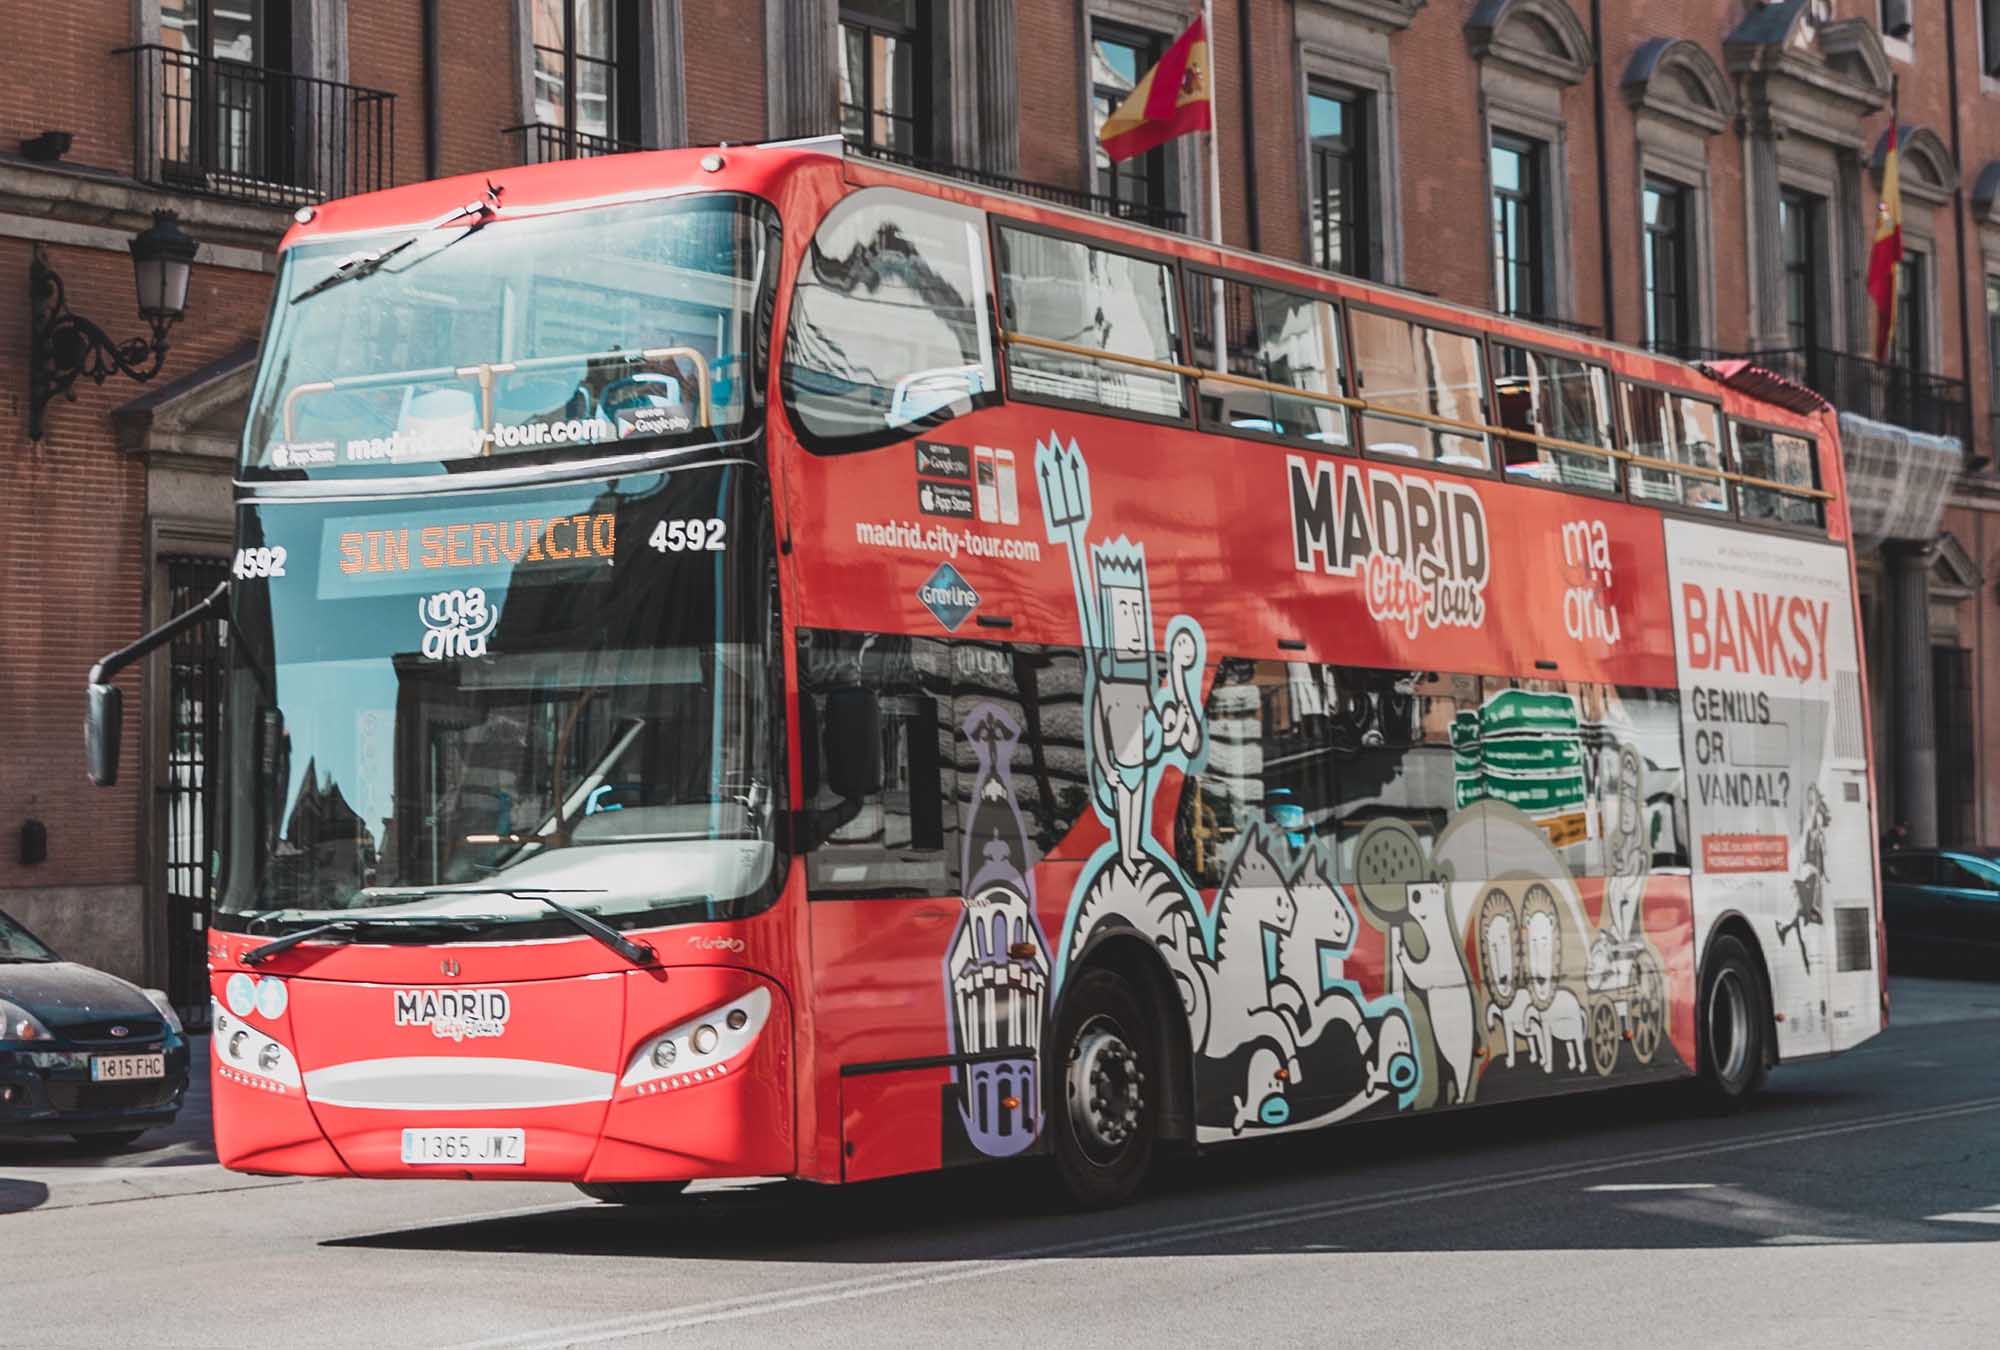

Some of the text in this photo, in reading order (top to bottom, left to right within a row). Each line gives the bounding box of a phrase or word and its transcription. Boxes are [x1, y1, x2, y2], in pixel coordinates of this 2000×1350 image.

[346, 418, 607, 460] madridy-tour.com
[648, 518, 727, 553] 4592
[855, 520, 1041, 561] madrid.city-tour.com
[1287, 456, 1489, 588] MADRID
[232, 545, 287, 580] 4592
[338, 512, 617, 576] SIN SERVICIO
[1561, 519, 1613, 571] ma
[1368, 553, 1484, 637] City Tour
[1681, 582, 1831, 682] BANKSY
[1692, 686, 1771, 725] GENIUS
[1694, 729, 1726, 765] OR
[1698, 771, 1791, 809] VANDAL?
[396, 992, 508, 1023] MADRID
[101, 1058, 161, 1077] 1815 FHC
[420, 1135, 519, 1158] 1365 JWZ
